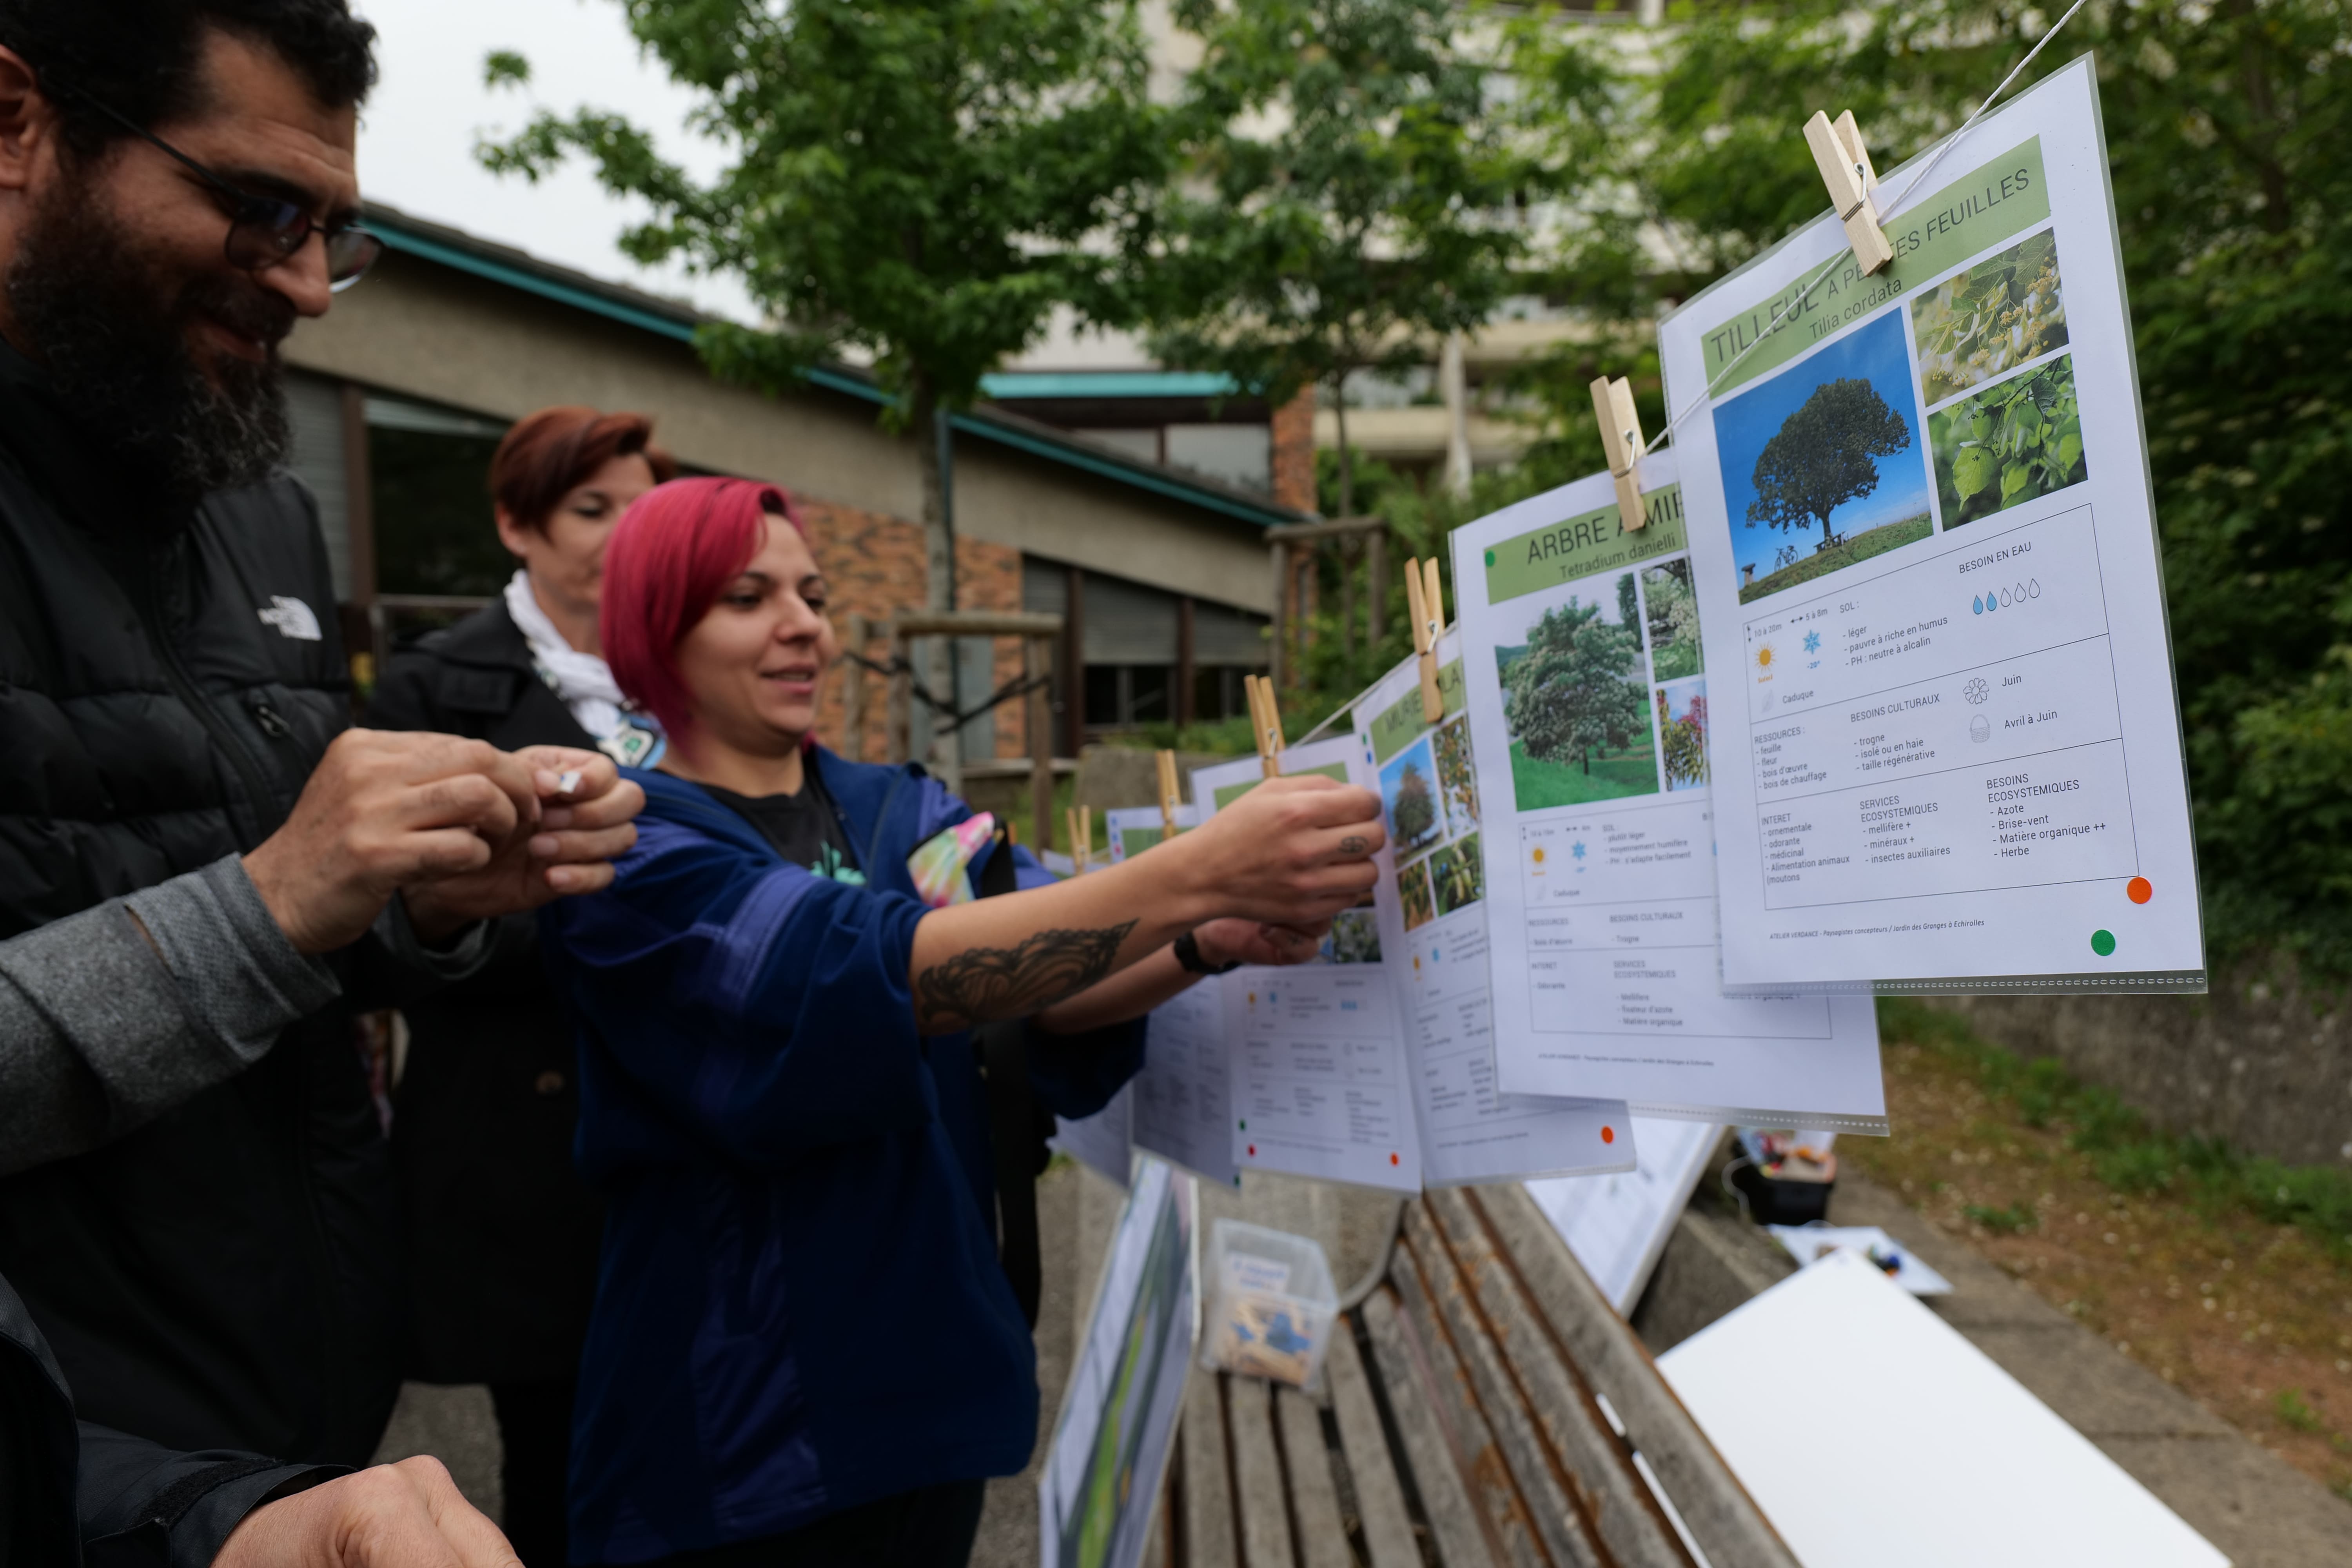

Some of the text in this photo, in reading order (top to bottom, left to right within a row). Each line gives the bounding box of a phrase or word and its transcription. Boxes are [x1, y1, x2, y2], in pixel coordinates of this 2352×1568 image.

[1710, 283, 1819, 362] TILLEUL
[1828, 279, 1839, 299] A
[1926, 169, 2029, 241] FEUILLES
[1809, 279, 1902, 339] Tilia cordata
[1528, 516, 1608, 564] ARBRE
[1560, 532, 1676, 579] Tetradium danielli
[1959, 541, 2031, 573] BESOIN EN EAU
[1806, 608, 1828, 621] 5 à 8m
[1839, 602, 1855, 613] SOL
[1848, 626, 1867, 638] léger
[1849, 617, 1948, 654] pauvre à riche en humus
[1851, 655, 1862, 666] PH
[1869, 648, 1894, 661] neutre
[1896, 644, 1901, 653] à
[1904, 637, 1931, 652] alcalin
[2002, 674, 2022, 687] Juin
[1782, 690, 1814, 704] Caduque
[1850, 693, 1940, 722] BESOINS CULTURAUX
[2004, 710, 2058, 729] Avril à Juin
[1754, 726, 1801, 744] RESSOURCES
[1859, 734, 1885, 746] trogne
[1761, 744, 1781, 755] feuille
[1861, 738, 1924, 759] isolé ou en haie
[1762, 757, 1777, 766] fleur
[1862, 750, 1935, 771] taille régénérative
[1762, 769, 1777, 778] bois
[1764, 771, 1827, 789] bois de chauffage
[1986, 773, 2029, 789] BESOINS
[1988, 780, 2080, 803] ECOSYSTEMIQUES
[1860, 795, 1900, 810] SERVICES
[1997, 804, 2024, 816] Azote
[1761, 813, 1791, 825] INTERET
[1861, 802, 1938, 822] ECOSYSTEMIQUES
[1768, 822, 1812, 836] ornementale
[1869, 822, 1904, 834] mellifère
[1998, 815, 2049, 830] Brise-vent
[2000, 831, 2036, 844] Matière
[2039, 825, 2090, 840] organique
[1769, 837, 1800, 848] odorante
[1870, 837, 1907, 849] minéraux
[1770, 847, 1804, 860] médicinal
[1871, 846, 1951, 864] insectes auxiliaires
[2001, 846, 2029, 857] Herbe
[1771, 856, 1850, 871] Alimentation animaux
[1766, 874, 1800, 886] (moutons
